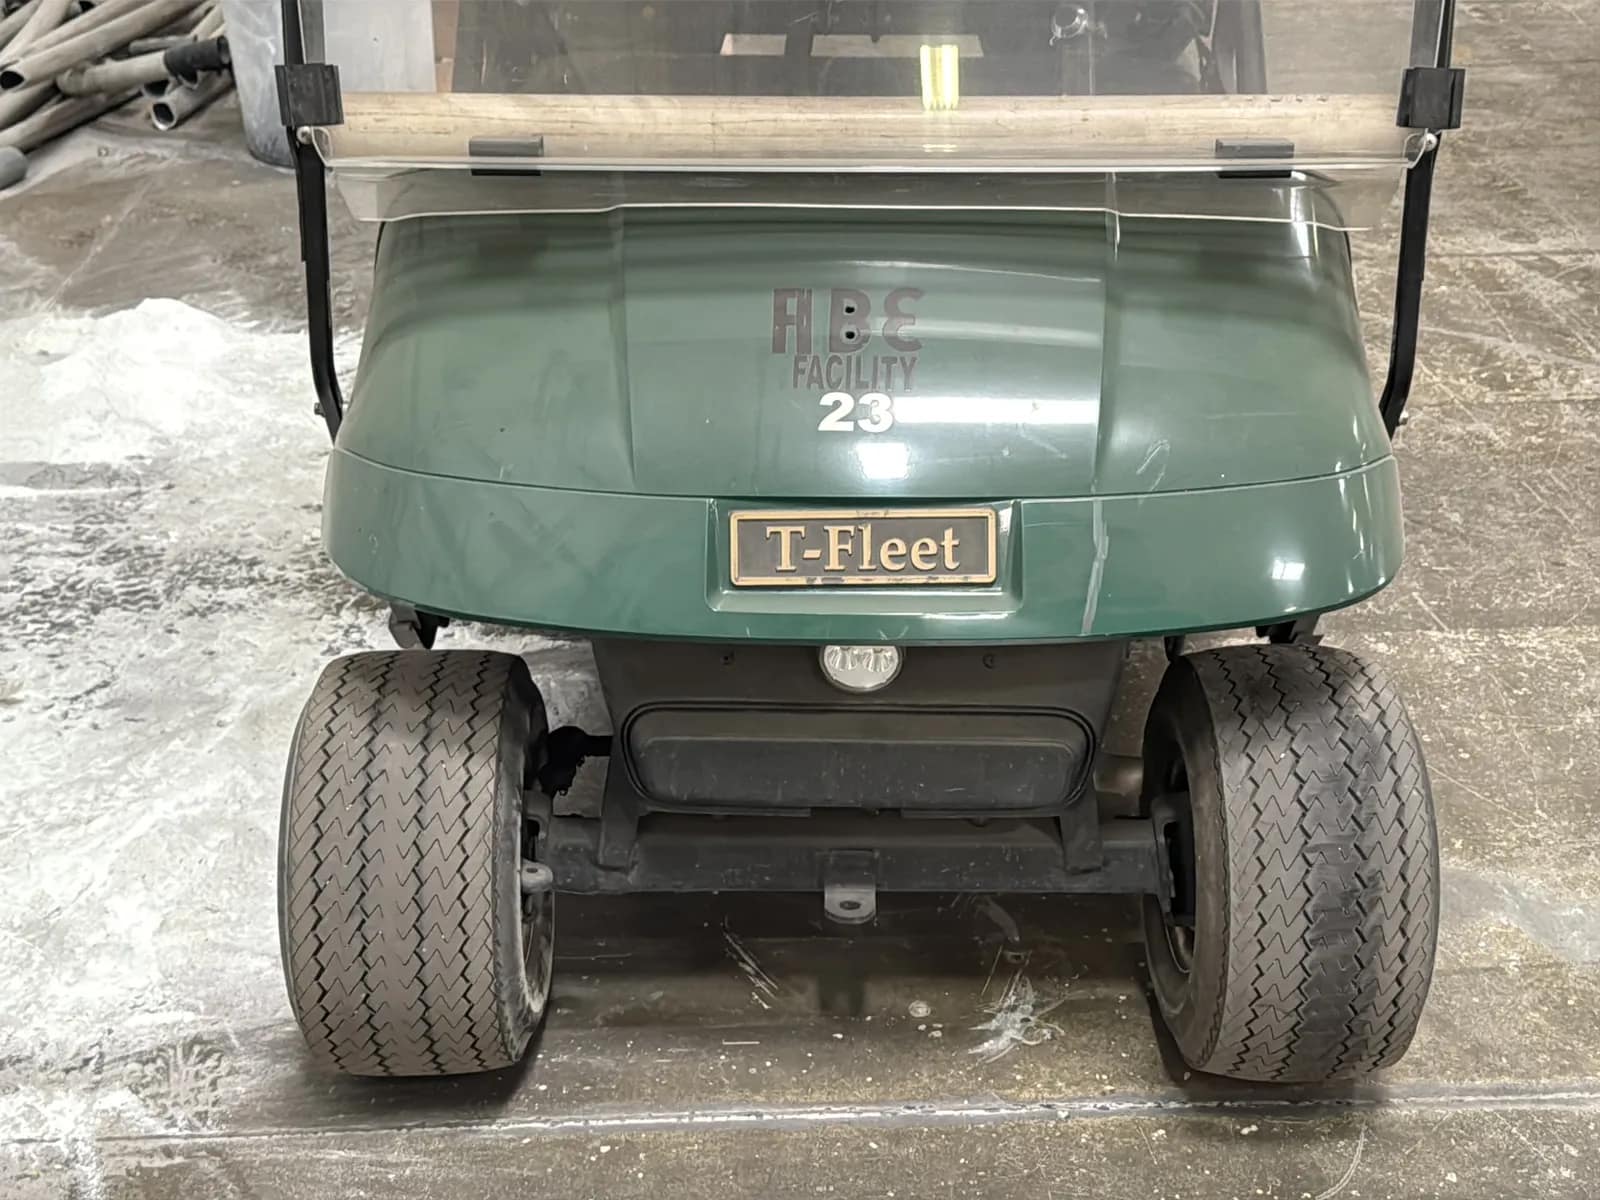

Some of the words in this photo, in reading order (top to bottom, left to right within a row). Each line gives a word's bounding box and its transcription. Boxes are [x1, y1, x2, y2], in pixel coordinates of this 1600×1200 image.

[793, 355, 917, 390] FACILITY
[818, 392, 893, 432] 23
[766, 523, 960, 571] T-Fleet
